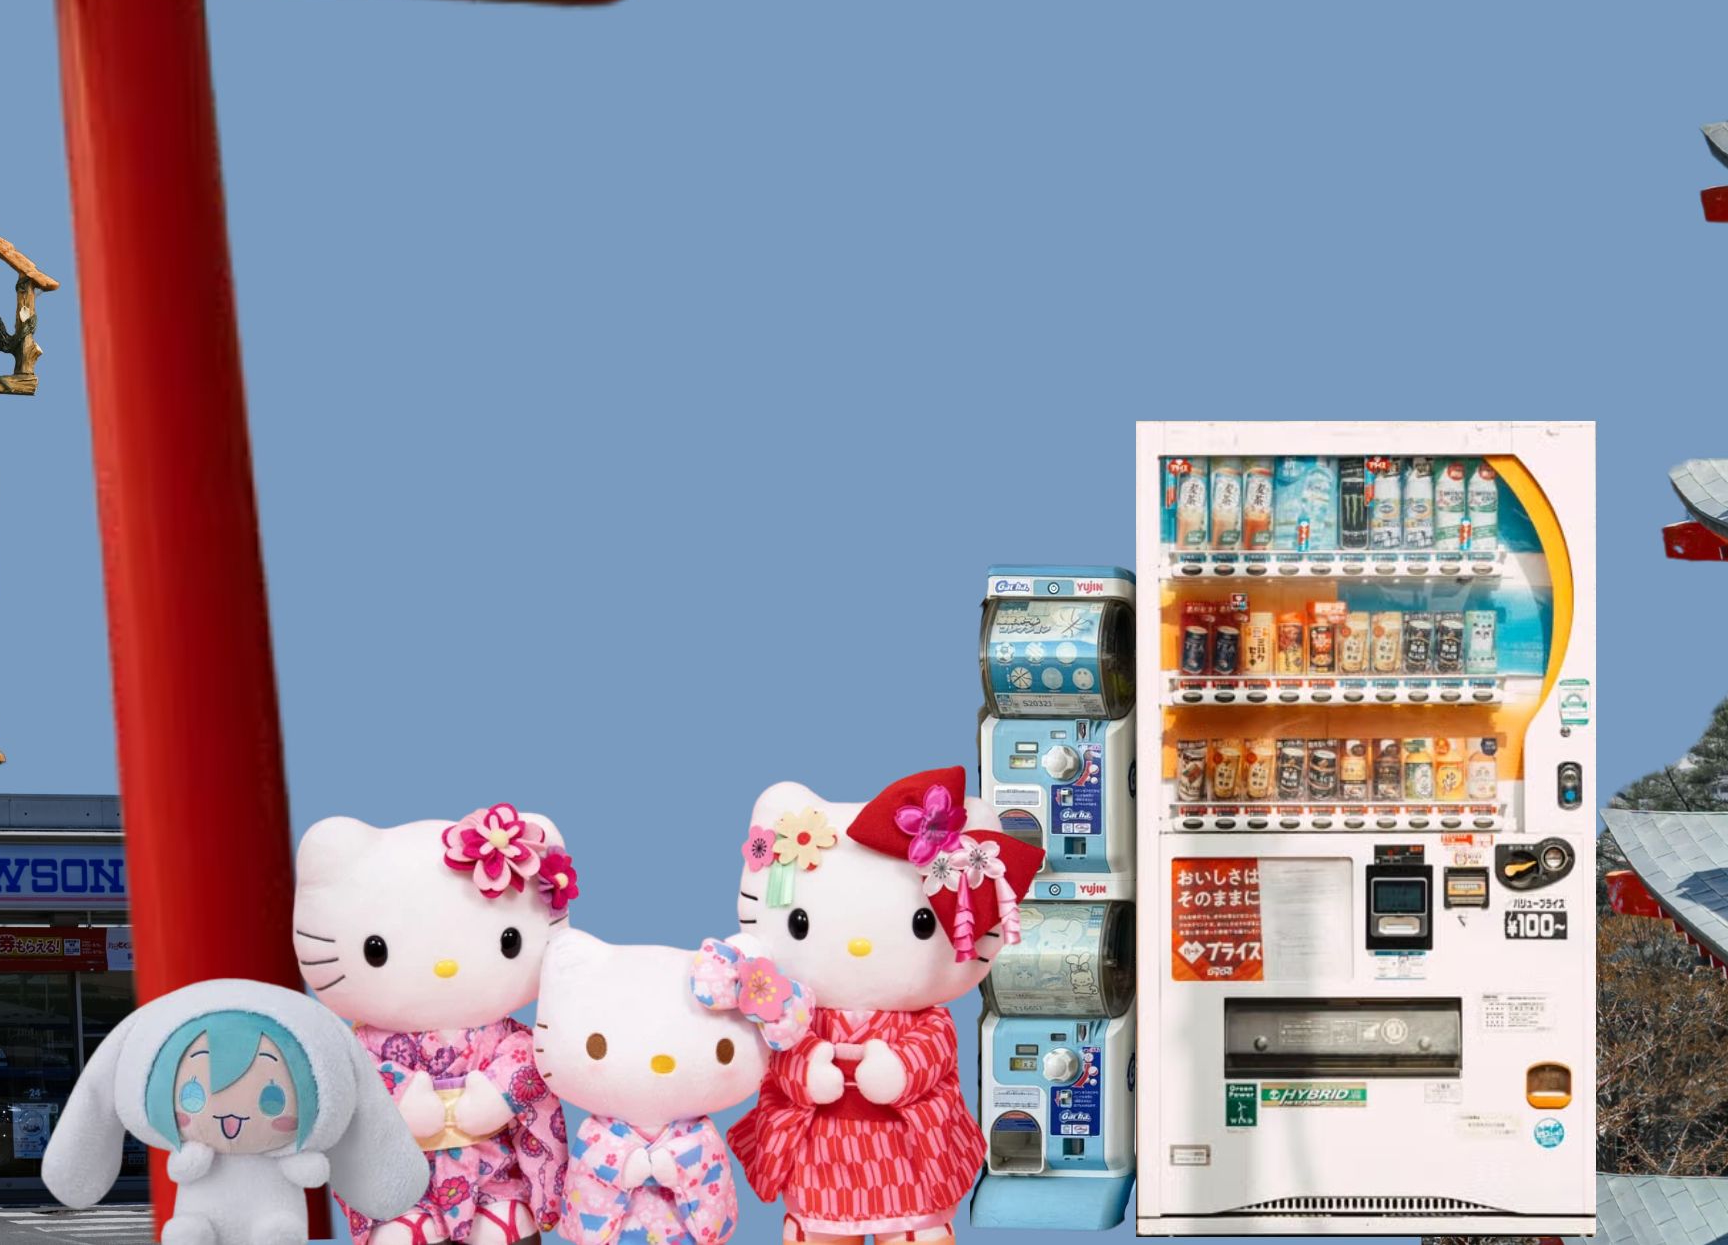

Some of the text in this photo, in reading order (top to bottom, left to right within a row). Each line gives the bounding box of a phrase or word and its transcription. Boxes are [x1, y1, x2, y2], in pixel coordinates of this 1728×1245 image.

[1177, 869, 1260, 886] おいしさは
[1178, 891, 1260, 907] そのままに
[1206, 942, 1262, 961] プライス
[1281, 1089, 1348, 1104] HYBRID
